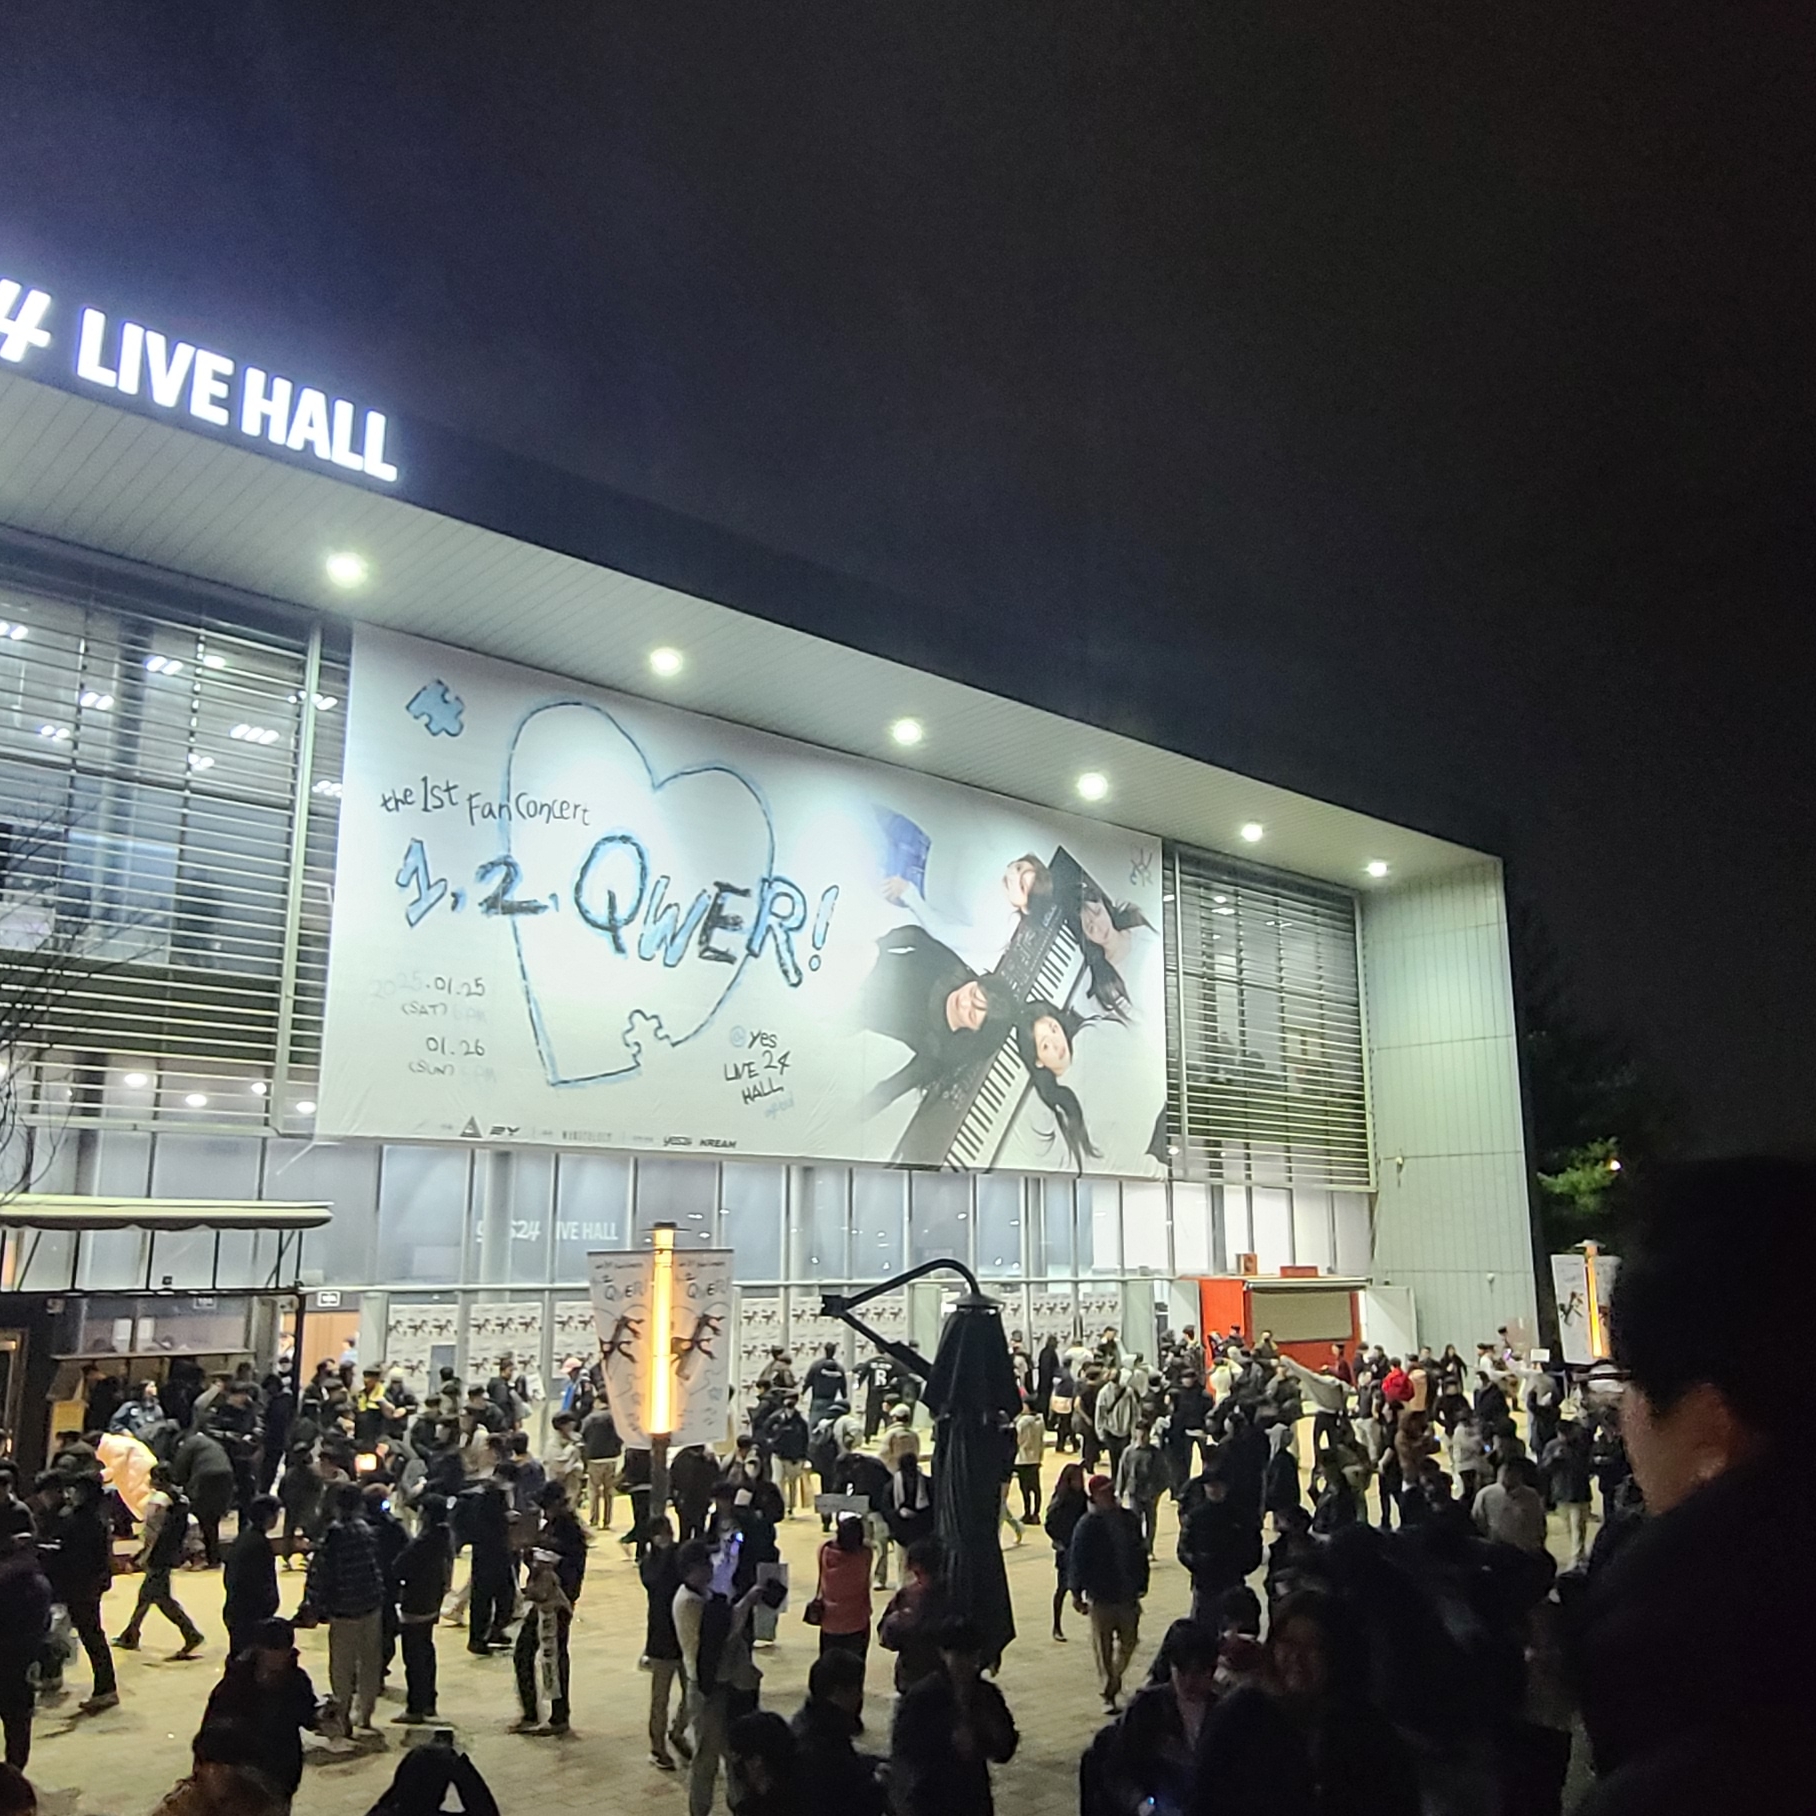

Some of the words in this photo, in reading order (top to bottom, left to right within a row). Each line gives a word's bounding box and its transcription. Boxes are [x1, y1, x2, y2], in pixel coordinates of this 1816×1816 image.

[77, 307, 234, 426] LIVE
[241, 367, 397, 482] HALL
[381, 786, 416, 813] the
[420, 775, 459, 813] 1st
[724, 1061, 759, 1081] LIVE
[761, 1049, 790, 1076] 24
[741, 1076, 785, 1105] HALL
[582, 1221, 619, 1240] HALL
